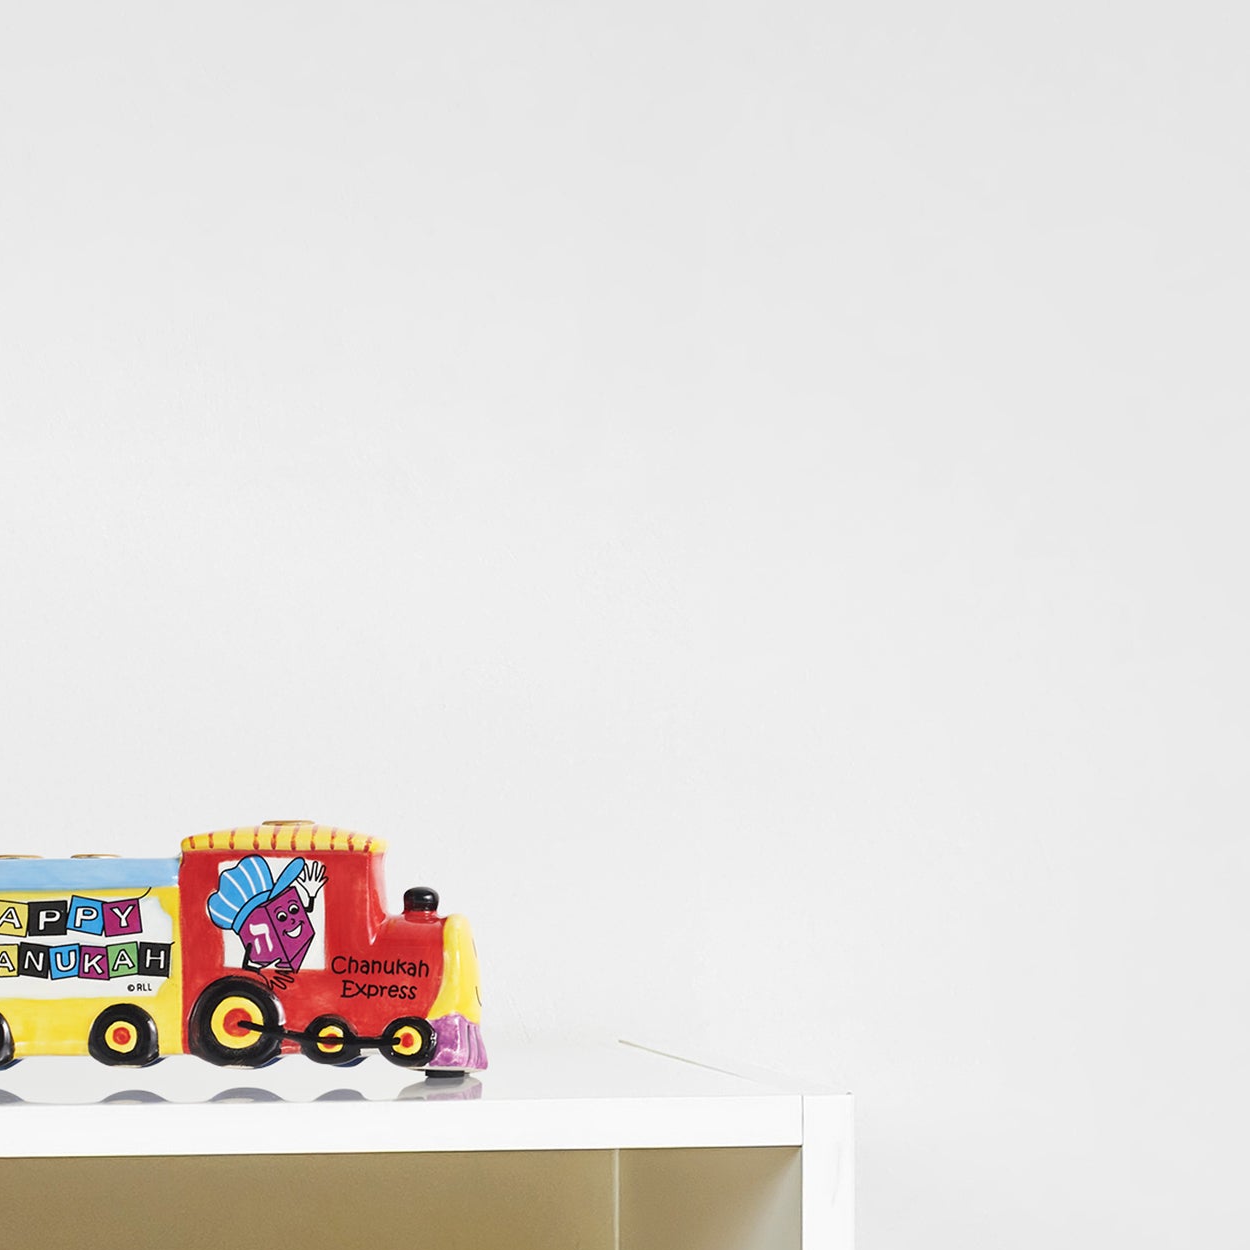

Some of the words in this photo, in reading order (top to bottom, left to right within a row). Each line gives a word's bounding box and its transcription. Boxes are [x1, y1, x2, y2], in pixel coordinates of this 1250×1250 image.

[249, 923, 273, 955] ה
[331, 955, 430, 978] Chanukah
[340, 979, 418, 1000] Express
